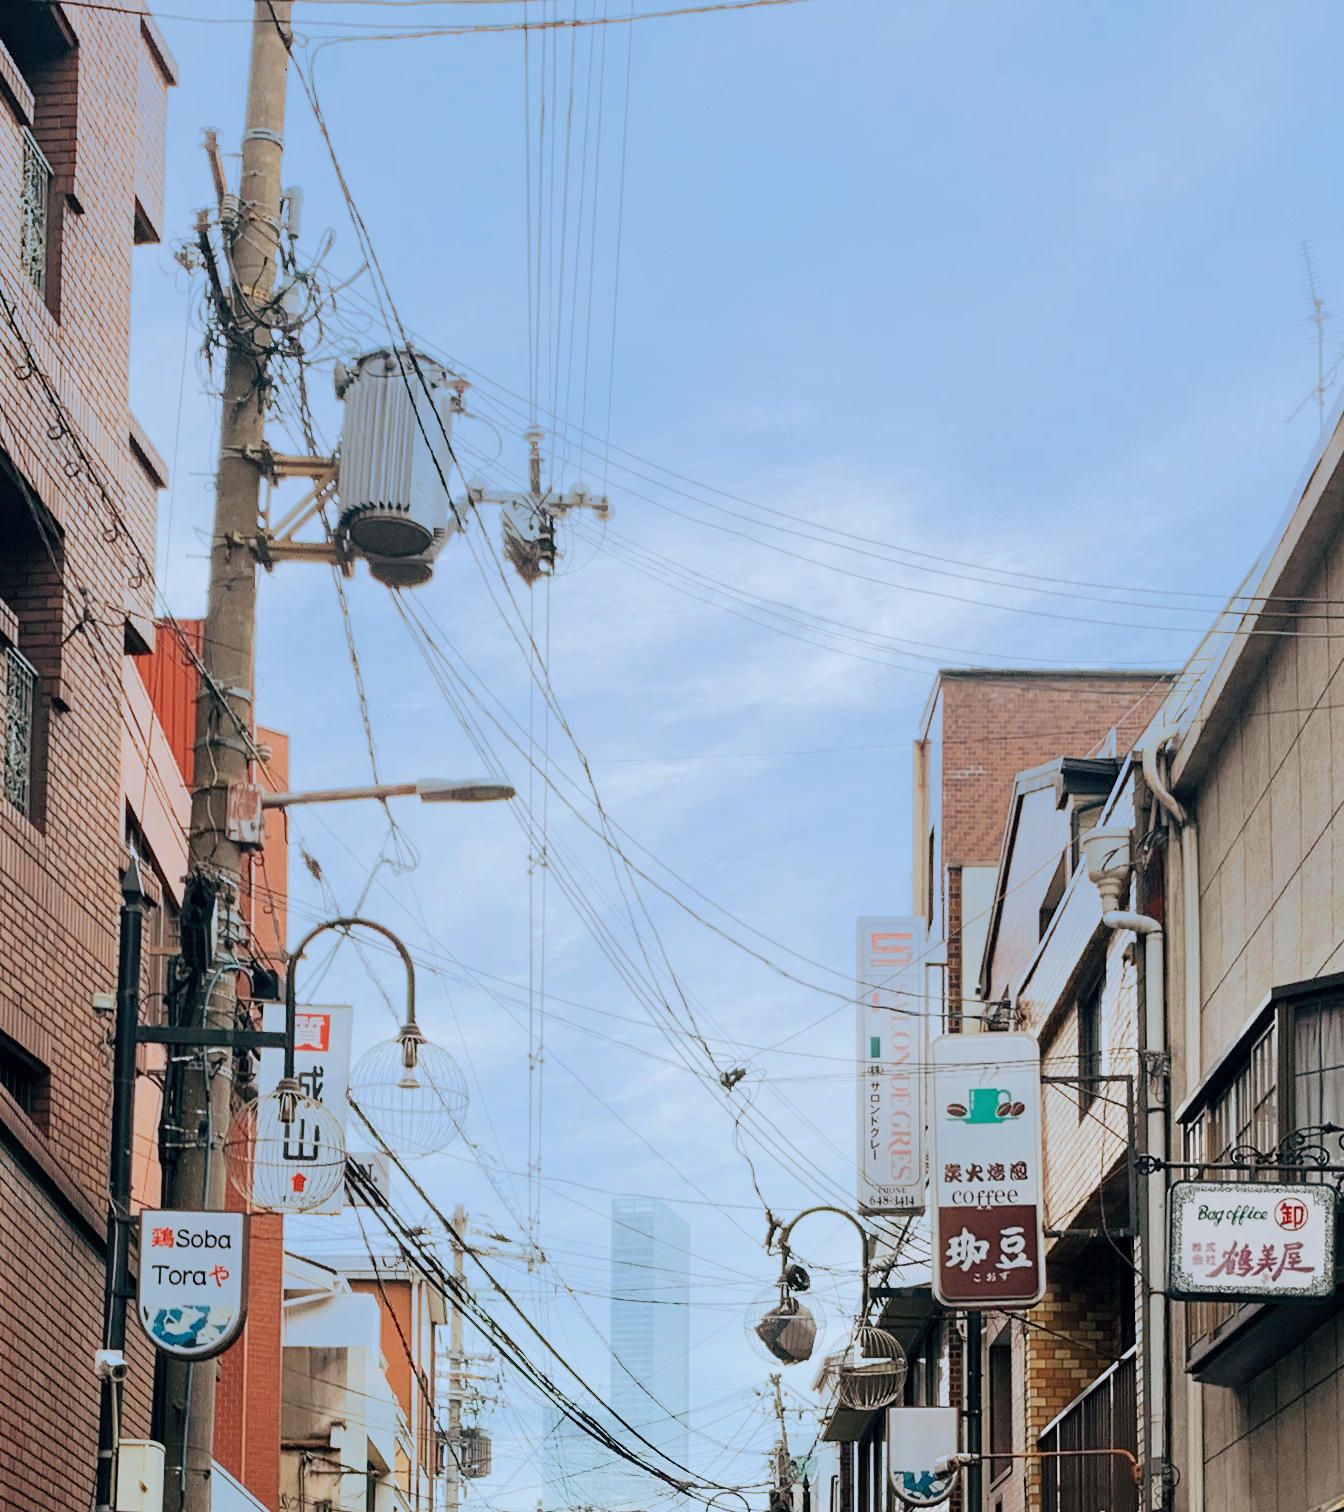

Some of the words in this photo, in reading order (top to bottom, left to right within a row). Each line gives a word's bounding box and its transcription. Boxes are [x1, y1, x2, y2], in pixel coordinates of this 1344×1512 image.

[887, 1110, 913, 1181] GRES
[944, 1160, 1028, 1183] 炭火焙煎
[952, 1188, 1019, 1210] coffee
[1197, 1205, 1224, 1227] Bag
[1226, 1204, 1269, 1227] office
[152, 1227, 231, 1250] 鶏Soba
[151, 1264, 230, 1288] Toraや
